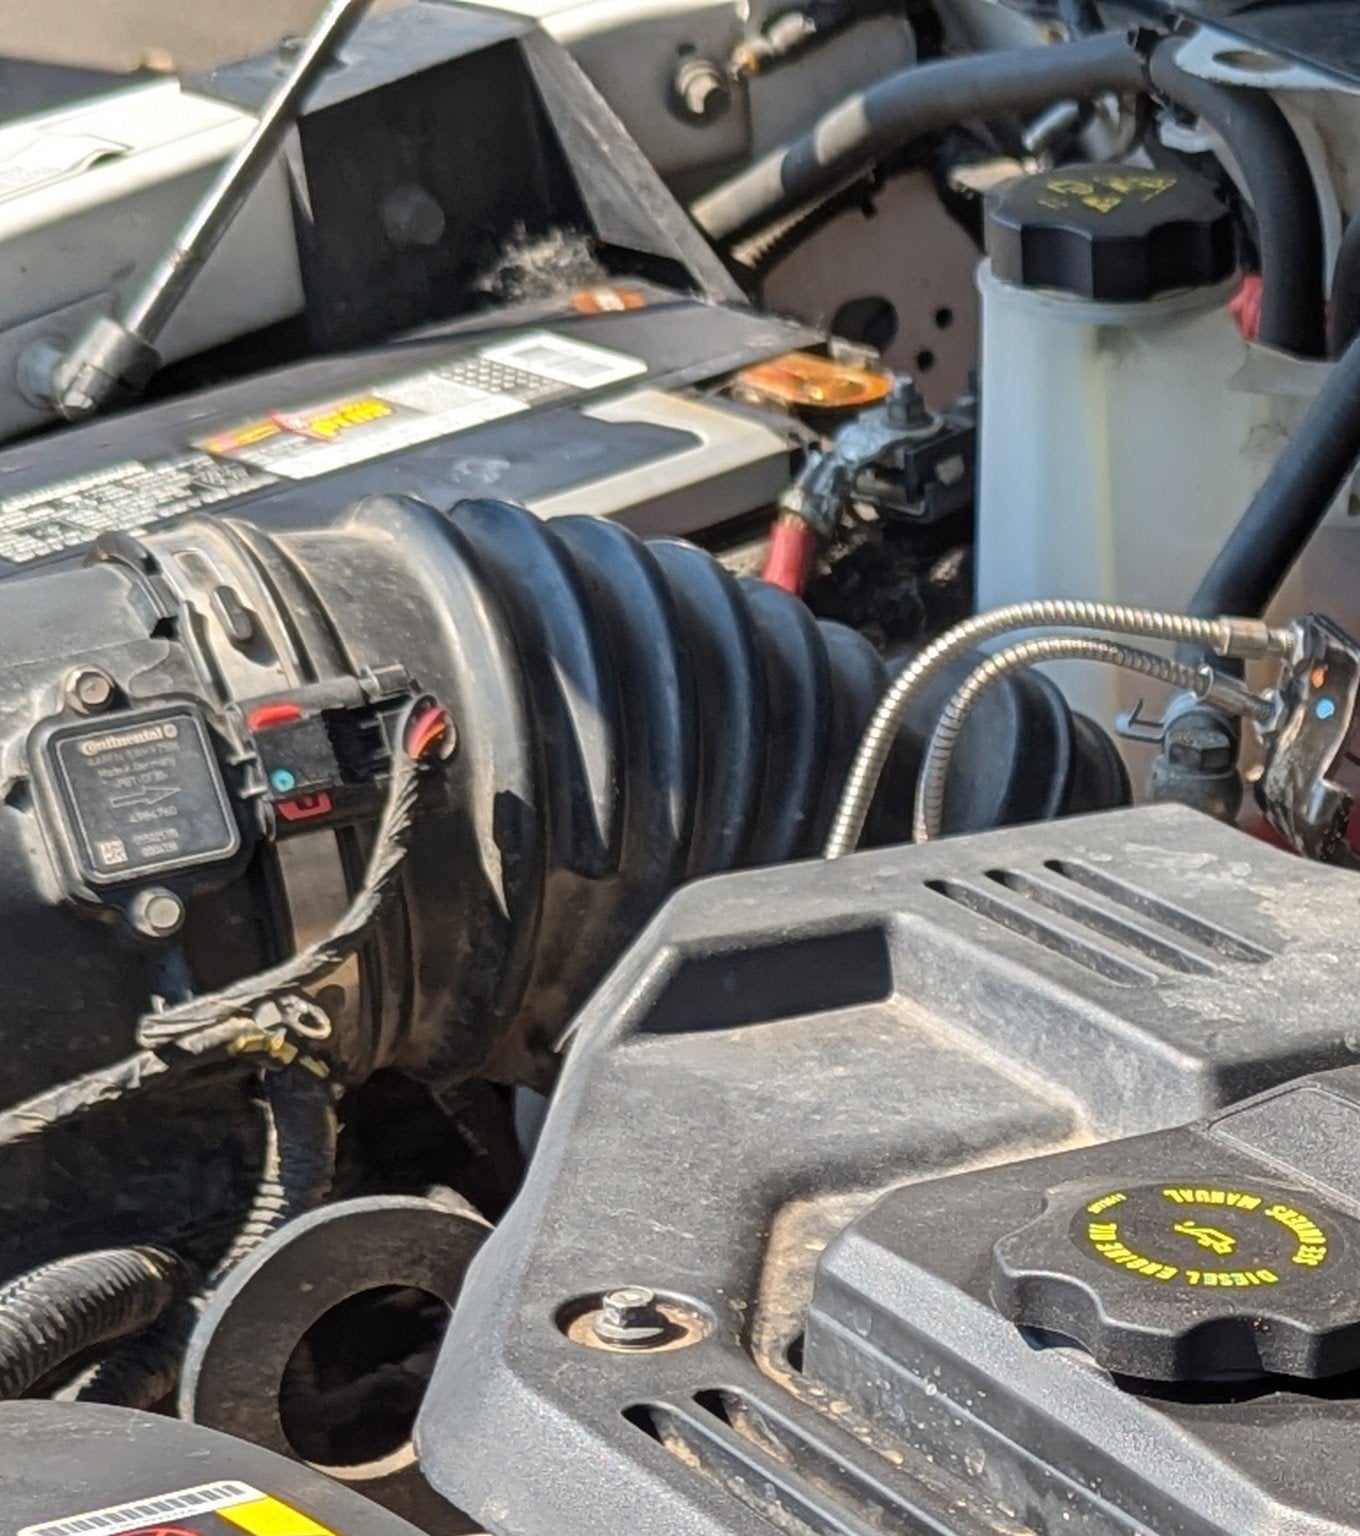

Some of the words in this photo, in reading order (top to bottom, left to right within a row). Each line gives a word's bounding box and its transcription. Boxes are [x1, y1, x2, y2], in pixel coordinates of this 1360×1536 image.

[1163, 1188, 1262, 1211] MANUAL
[1096, 1242, 1178, 1281] ENGINE
[1186, 1268, 1279, 1287] DIESEL
